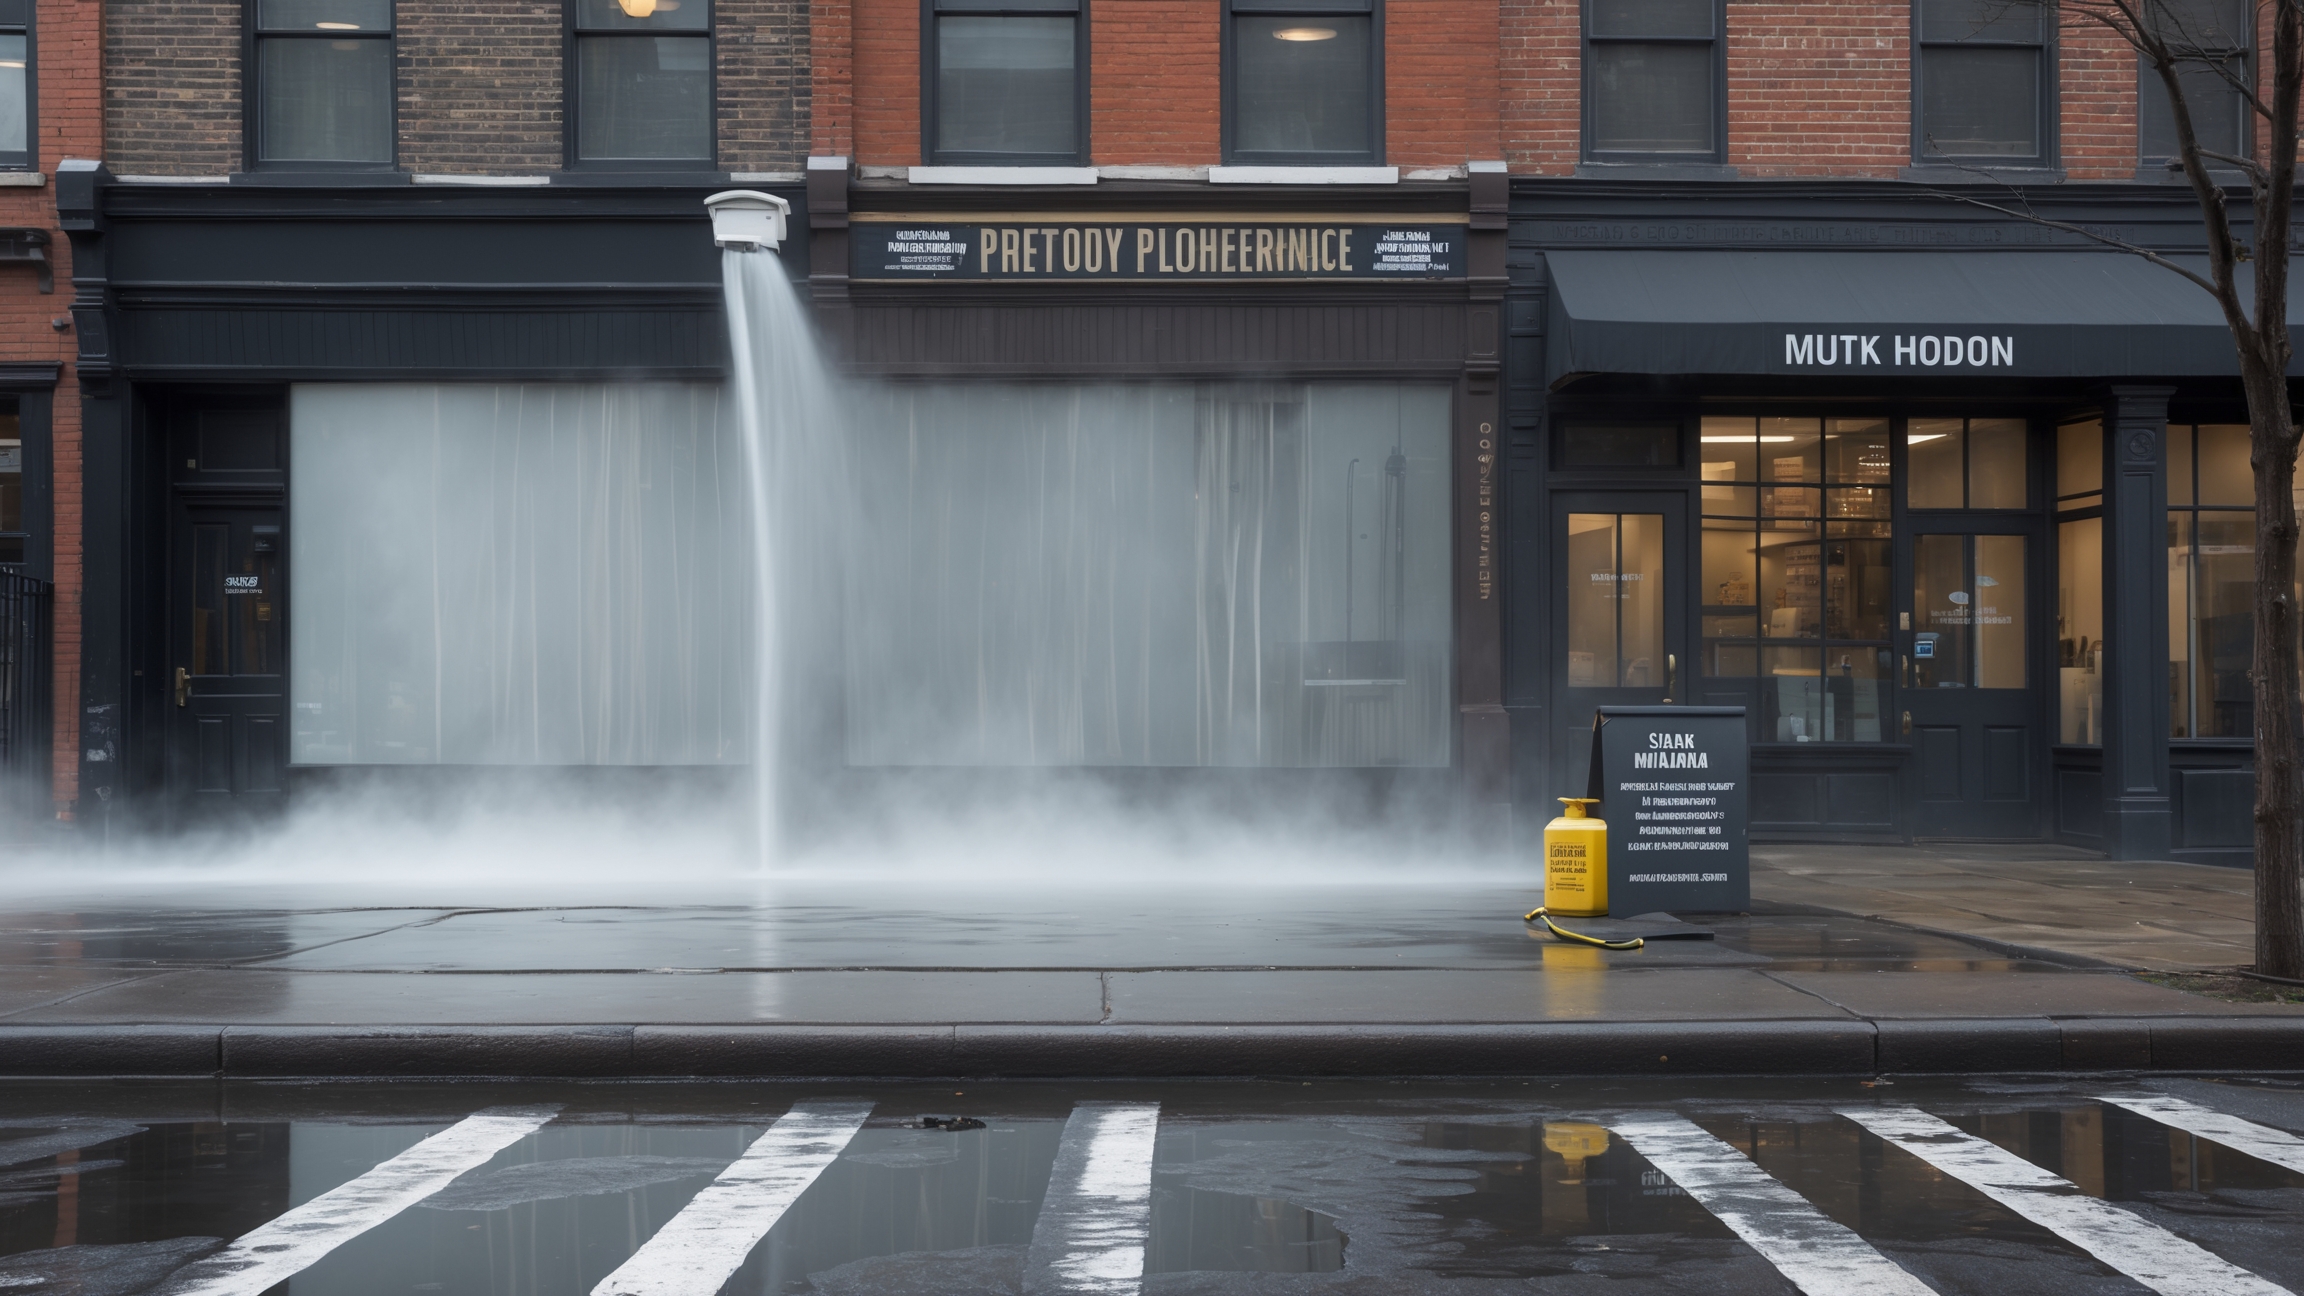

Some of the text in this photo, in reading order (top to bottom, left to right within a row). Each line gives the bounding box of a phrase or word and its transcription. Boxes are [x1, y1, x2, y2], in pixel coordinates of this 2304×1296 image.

[980, 228, 1124, 273] PRETODY
[1785, 333, 2014, 367] MUTK HODON
